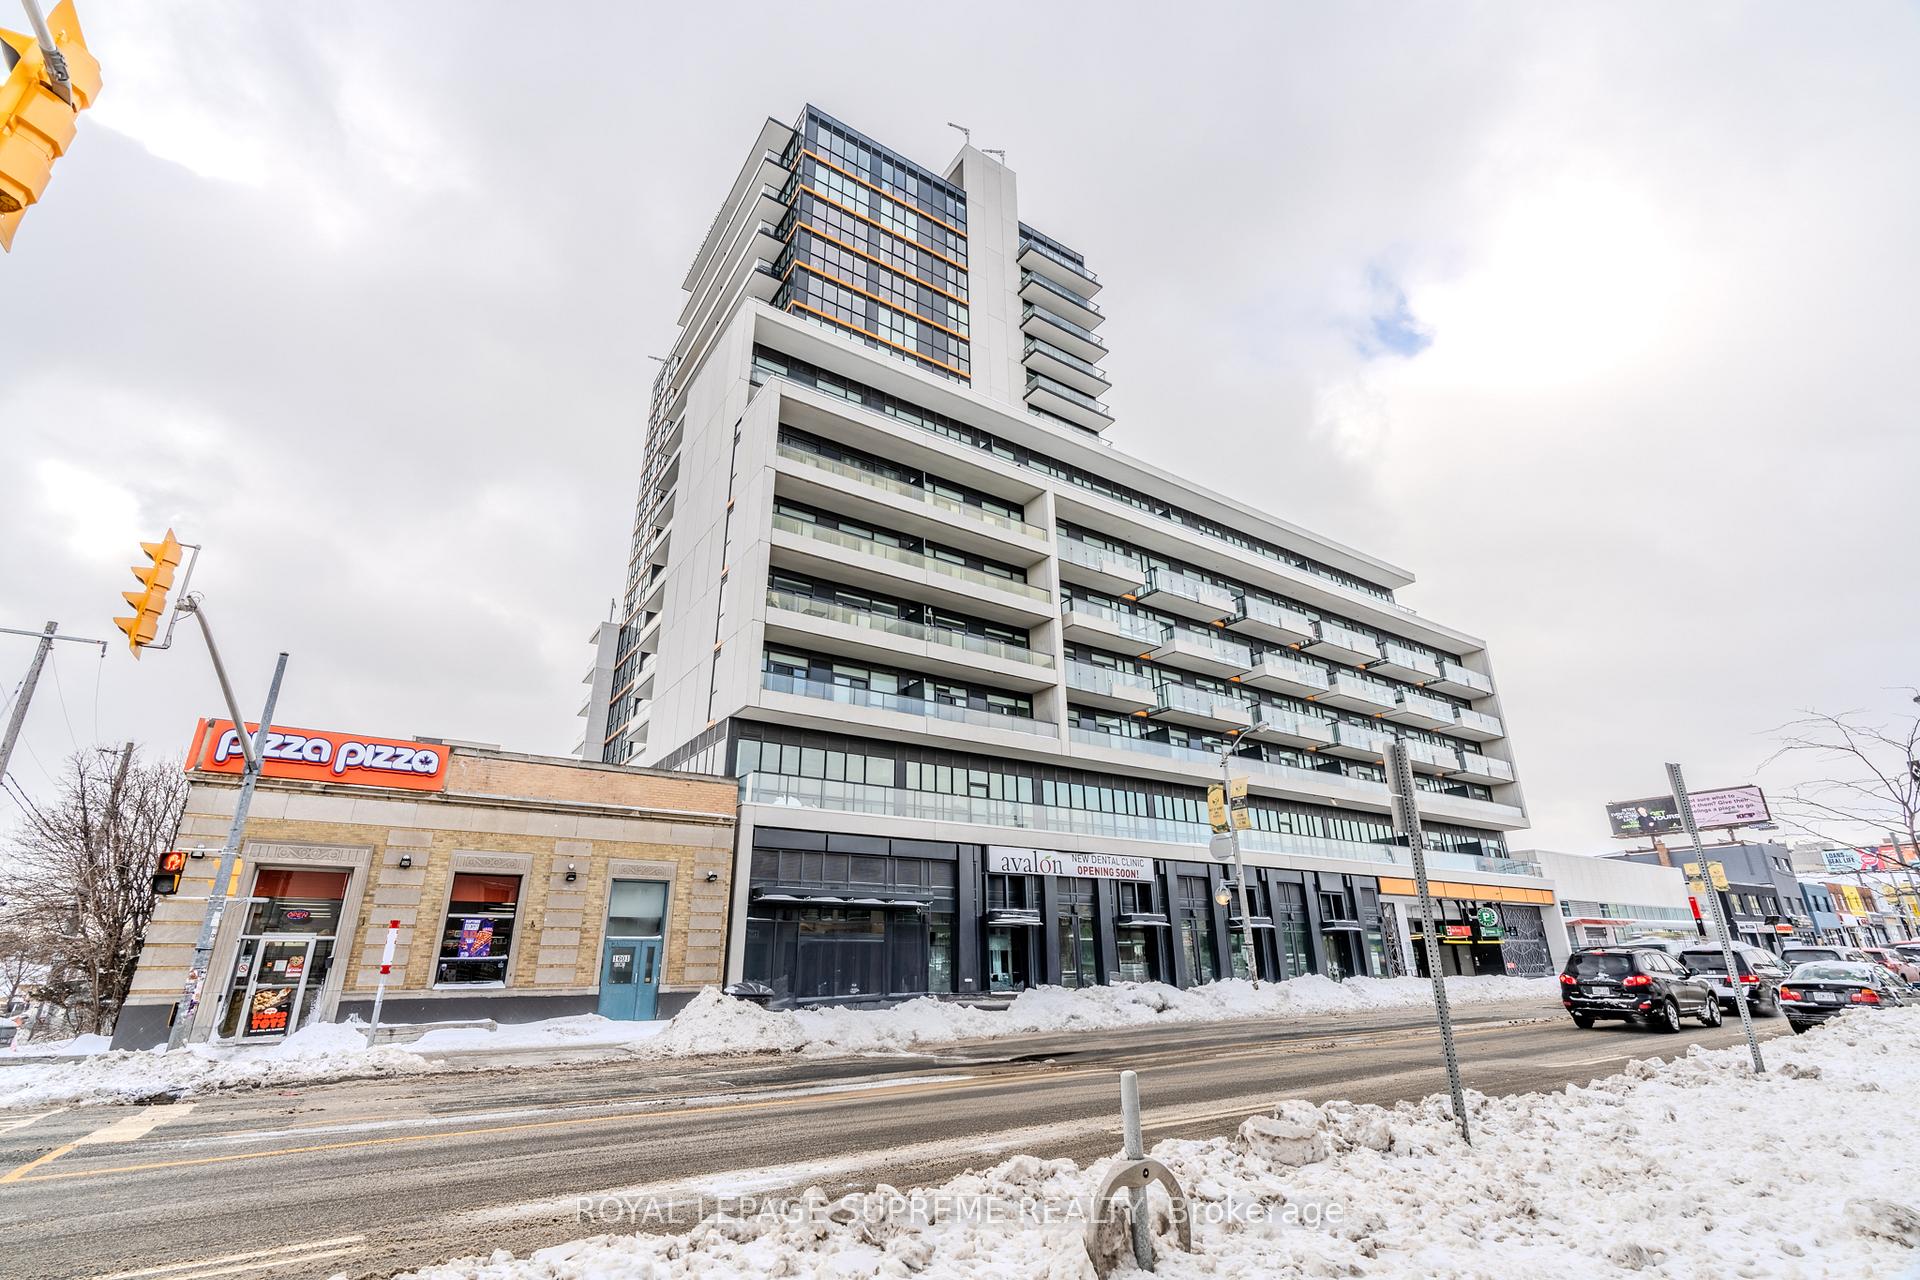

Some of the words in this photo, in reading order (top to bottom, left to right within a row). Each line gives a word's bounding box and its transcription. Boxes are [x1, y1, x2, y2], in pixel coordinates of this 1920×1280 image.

[215, 729, 332, 763] pzza
[334, 741, 440, 774] pizza
[1718, 804, 1735, 812] place
[1071, 853, 1089, 863] NEW
[1091, 855, 1120, 866] DENTAL
[1122, 857, 1145, 868] CLINIC
[1077, 866, 1115, 877] OPENING
[1116, 868, 1140, 878] SOON!
[287, 910, 309, 919] OPEN
[1482, 912, 1490, 921] P
